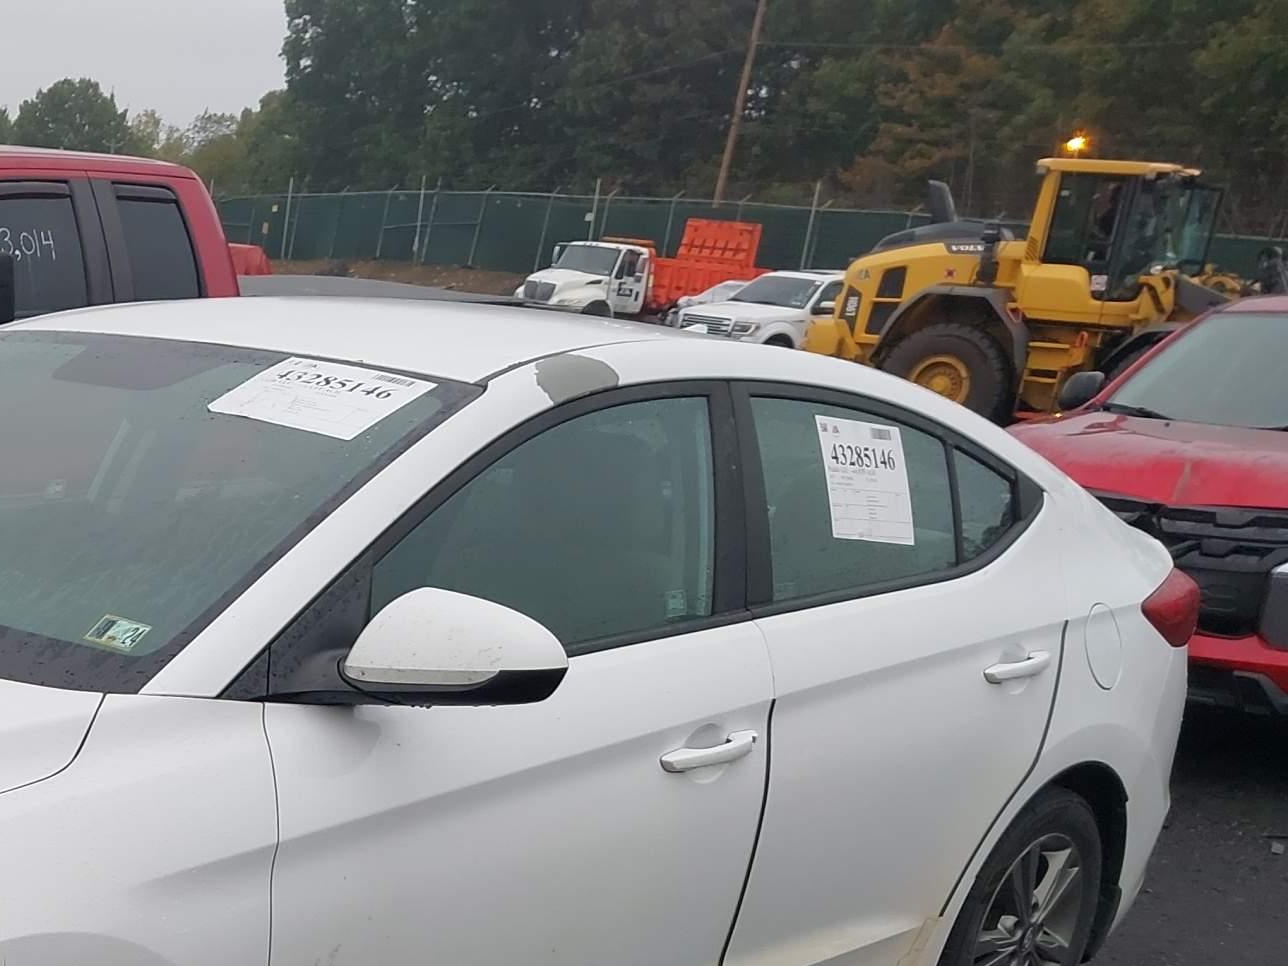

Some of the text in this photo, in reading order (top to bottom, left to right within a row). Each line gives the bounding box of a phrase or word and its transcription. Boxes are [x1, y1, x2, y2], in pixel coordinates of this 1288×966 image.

[951, 244, 985, 252] VOLV
[276, 369, 393, 400] 43285146
[831, 443, 896, 471] 43285146
